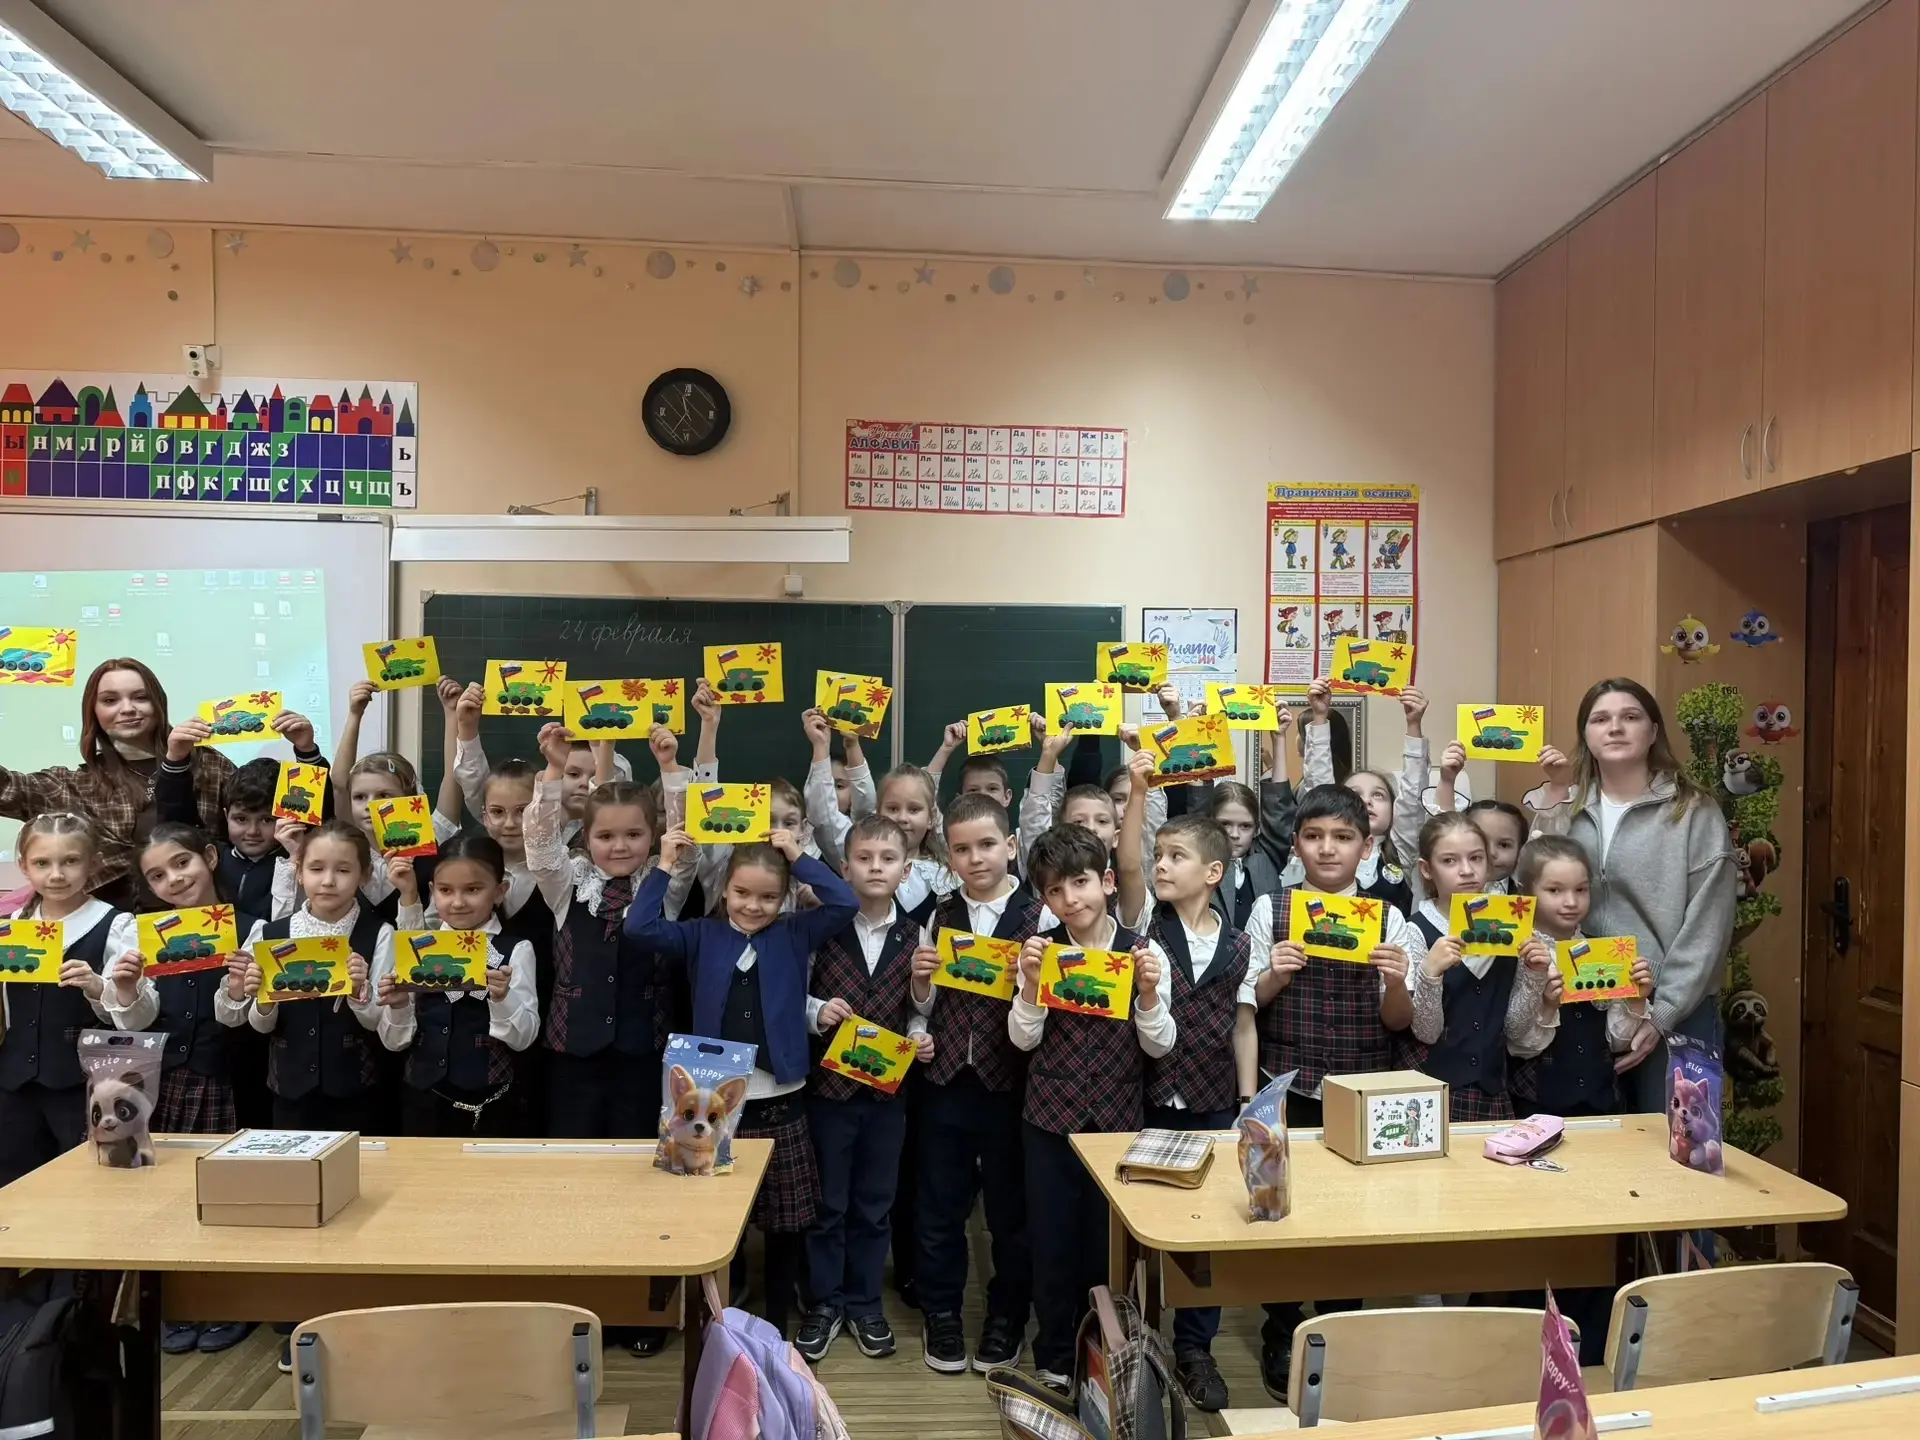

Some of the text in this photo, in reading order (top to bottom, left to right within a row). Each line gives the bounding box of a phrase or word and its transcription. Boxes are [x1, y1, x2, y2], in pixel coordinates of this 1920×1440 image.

[868, 424, 912, 439] Русский
[33, 436, 48, 449] н
[56, 437, 73, 450] м
[81, 438, 96, 451] л
[106, 438, 121, 457] р
[131, 434, 145, 452] й
[156, 435, 168, 453] б
[180, 441, 193, 454] в
[205, 441, 217, 454] г
[227, 442, 241, 458] д
[251, 442, 270, 456] ж
[278, 443, 289, 457] з
[850, 439, 920, 450] АЛФАВИТ
[156, 475, 170, 488] п
[177, 471, 194, 495] ф
[204, 476, 218, 490] к
[229, 477, 242, 491] т
[248, 478, 270, 491] ш
[278, 478, 289, 492] с
[301, 480, 313, 493] х
[325, 480, 340, 496] ц
[349, 481, 363, 494] ч
[369, 482, 390, 498] щ
[1274, 485, 1412, 499] Правильная осанка
[559, 612, 696, 655] 24 февраля
[1168, 655, 1215, 665] ОССИИ
[1722, 687, 1738, 695] 160
